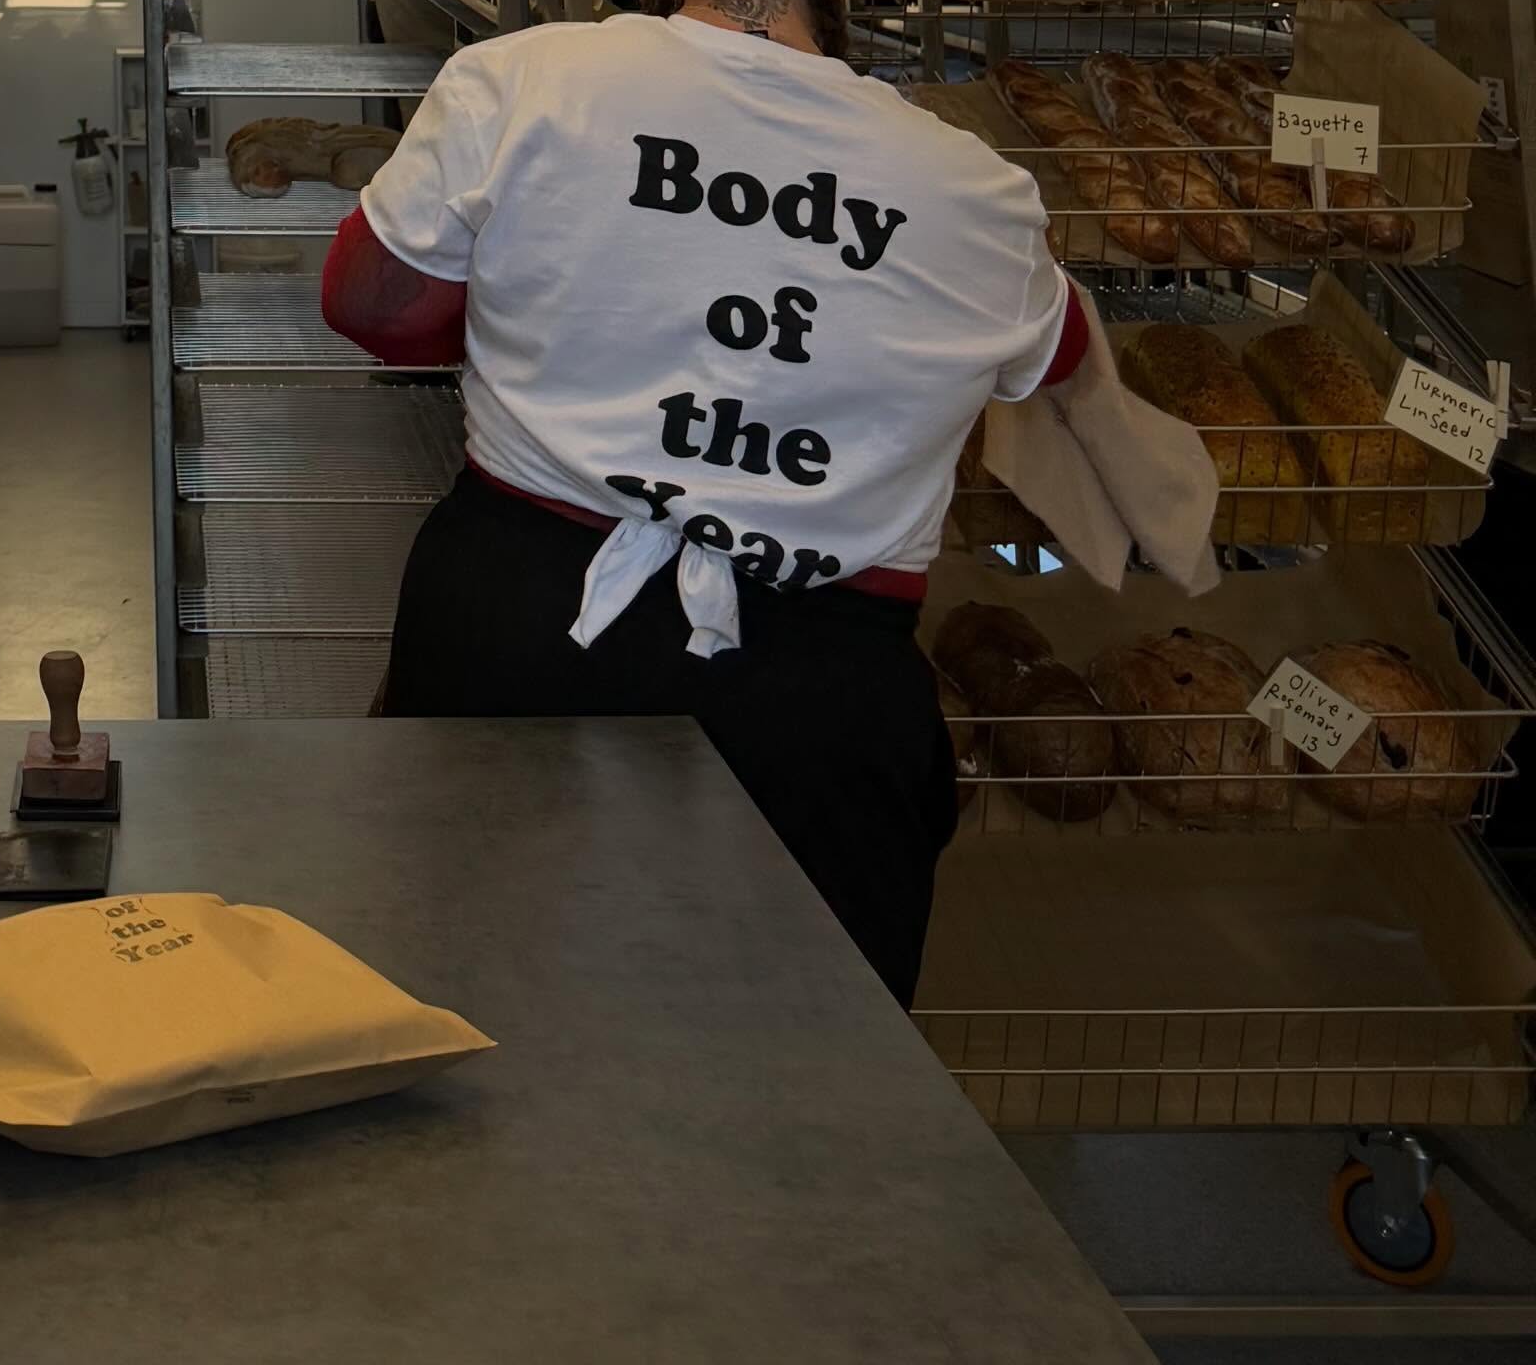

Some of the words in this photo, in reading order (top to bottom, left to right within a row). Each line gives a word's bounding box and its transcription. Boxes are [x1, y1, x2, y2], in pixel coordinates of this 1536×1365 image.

[1278, 111, 1364, 135] Baguette
[1354, 146, 1369, 165] 7
[629, 134, 906, 271] Body
[706, 287, 818, 364] of
[658, 391, 831, 486] the
[1468, 446, 1485, 465] 12
[1289, 674, 1339, 717] Olive
[1264, 682, 1342, 747] Rosemary
[1301, 733, 1319, 752] 13
[111, 918, 167, 939] the
[115, 933, 194, 962] Year
